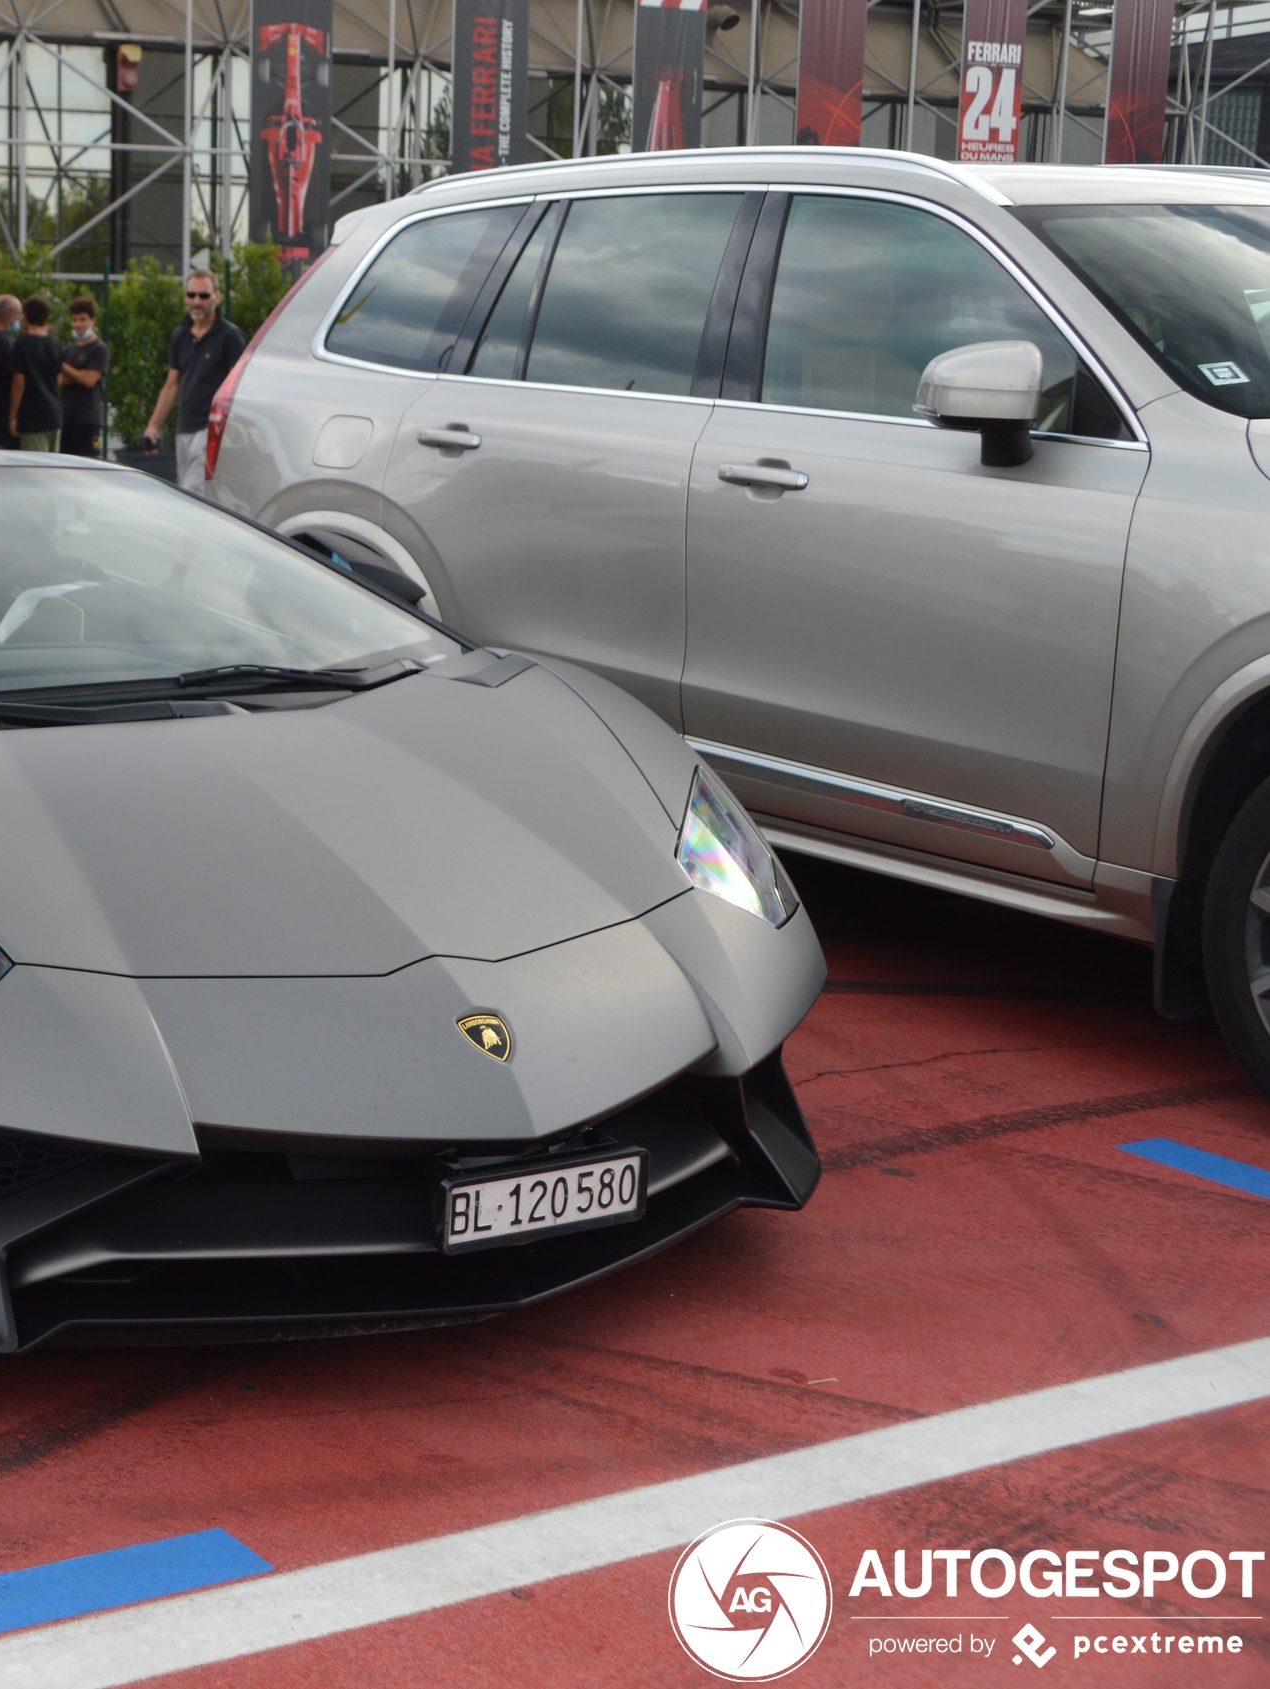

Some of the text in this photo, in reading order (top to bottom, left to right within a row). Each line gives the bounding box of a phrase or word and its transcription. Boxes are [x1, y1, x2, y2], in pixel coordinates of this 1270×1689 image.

[500, 18, 514, 70] HISTORY
[967, 41, 1022, 64] FERRARI
[470, 16, 498, 136] FERRARI
[498, 71, 512, 132] COMPLETE
[962, 65, 1017, 142] 24
[498, 133, 510, 156] THE
[960, 151, 1014, 162] DU MANS
[961, 141, 1014, 153] HEURES
